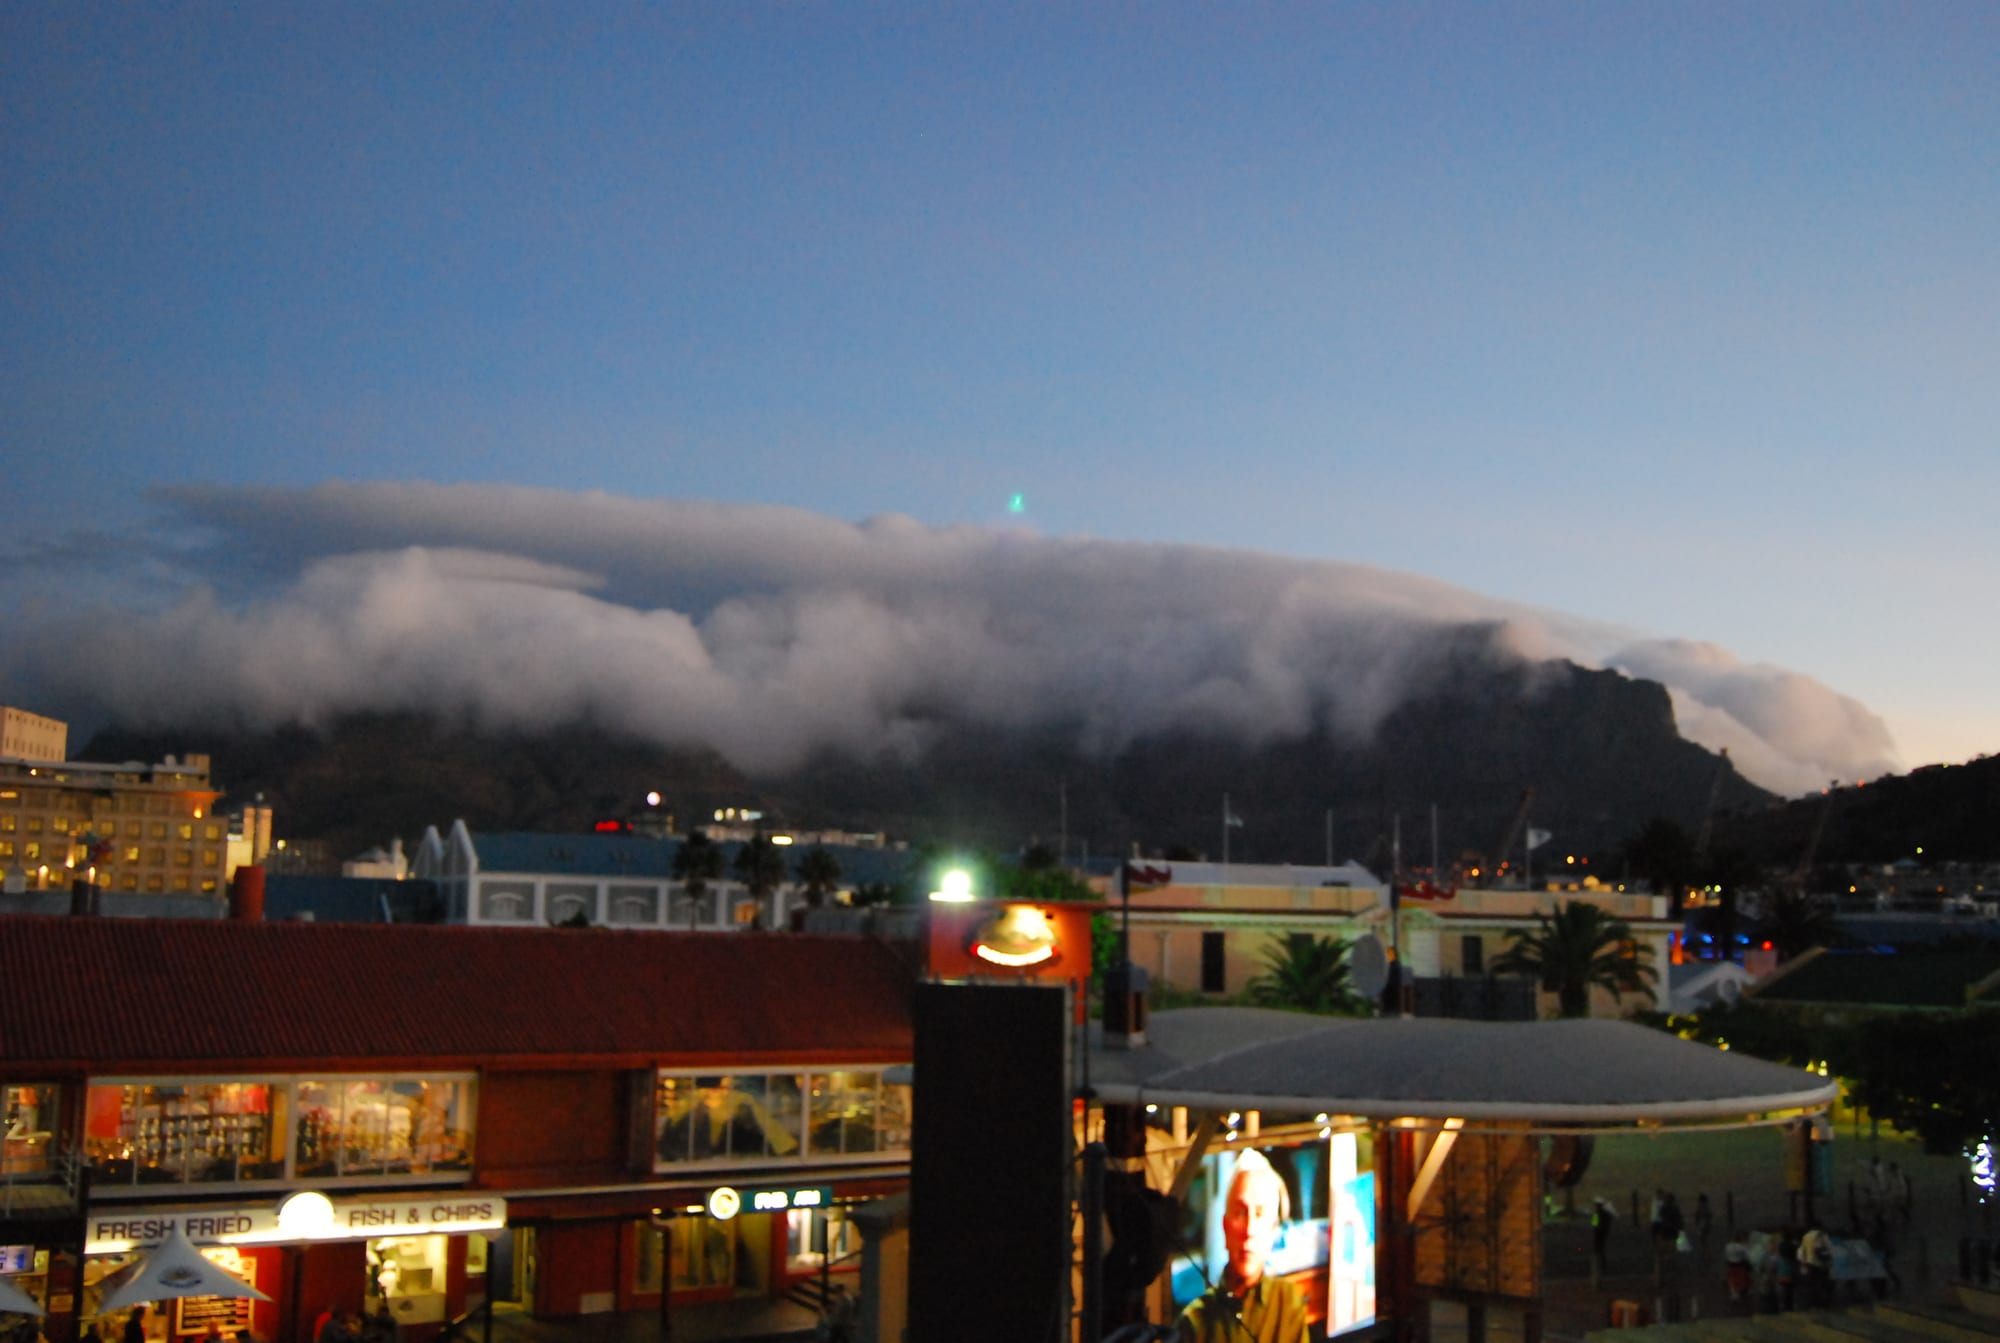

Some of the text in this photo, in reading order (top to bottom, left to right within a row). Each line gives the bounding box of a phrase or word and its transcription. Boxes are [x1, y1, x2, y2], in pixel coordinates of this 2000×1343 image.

[97, 1202, 492, 1240] FRESH FRIED FISH & CHIPS
